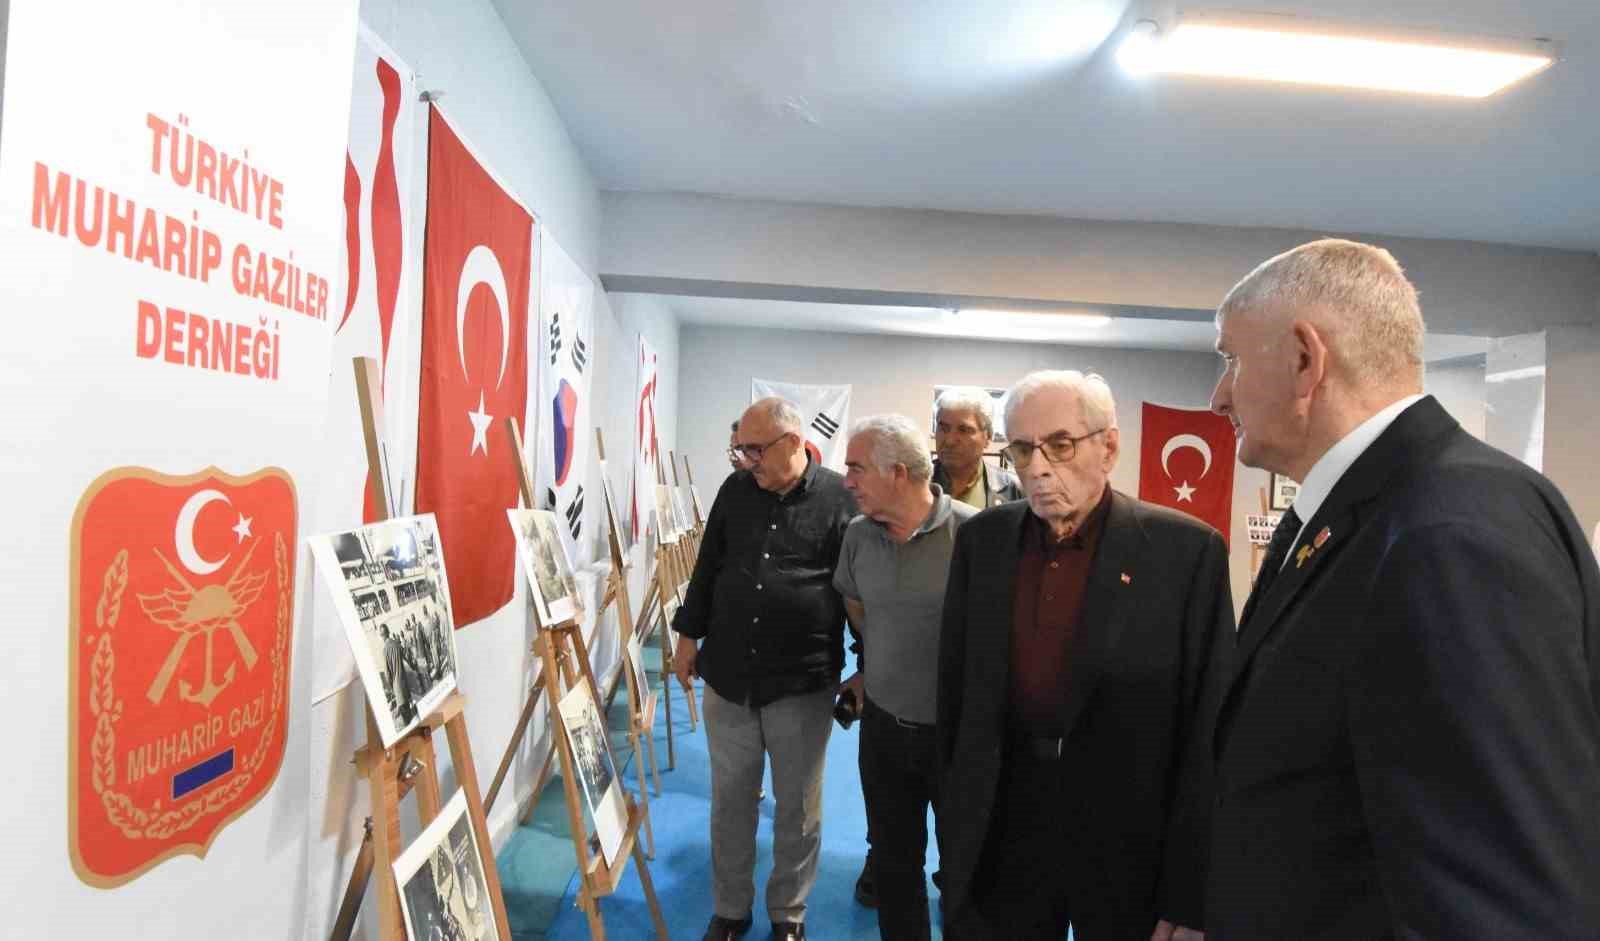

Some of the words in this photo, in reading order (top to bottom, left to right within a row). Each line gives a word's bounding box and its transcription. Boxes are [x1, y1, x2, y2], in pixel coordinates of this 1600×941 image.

[146, 112, 283, 229] TÜRKİYE
[32, 160, 222, 283] MUHARİP
[231, 243, 328, 321] GAZİLER
[136, 299, 279, 380] DERNEĞİ
[127, 712, 222, 784] MUHARİP
[229, 689, 265, 738] GAZİ
